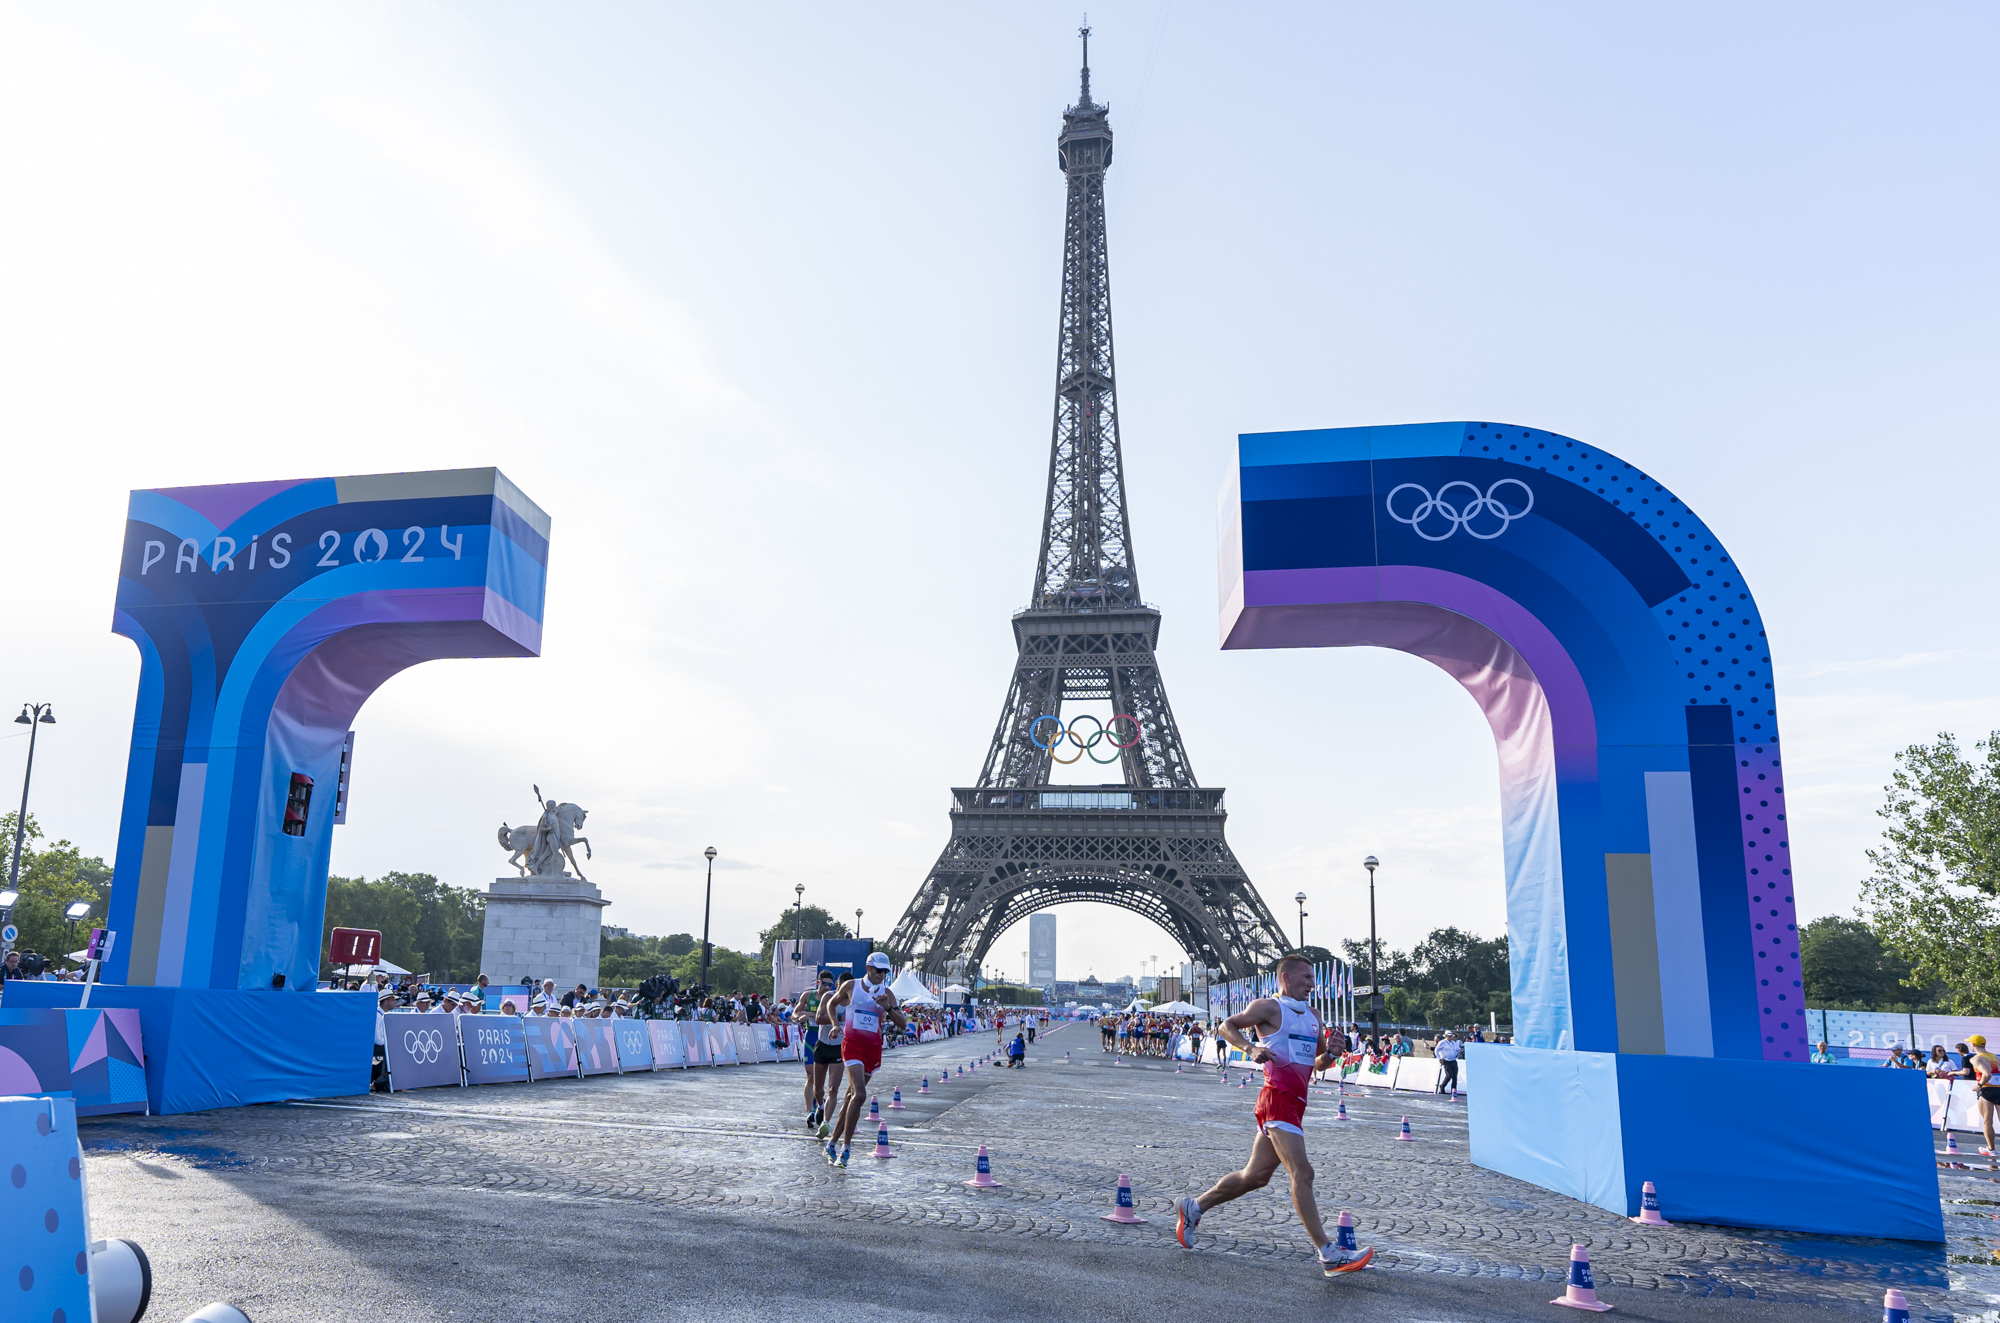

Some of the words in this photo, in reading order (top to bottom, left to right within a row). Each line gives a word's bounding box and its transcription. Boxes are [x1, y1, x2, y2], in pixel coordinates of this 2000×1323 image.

[316, 525, 463, 567] 2024
[480, 1048, 513, 1065] 2024
[1302, 1043, 1312, 1053] 70
